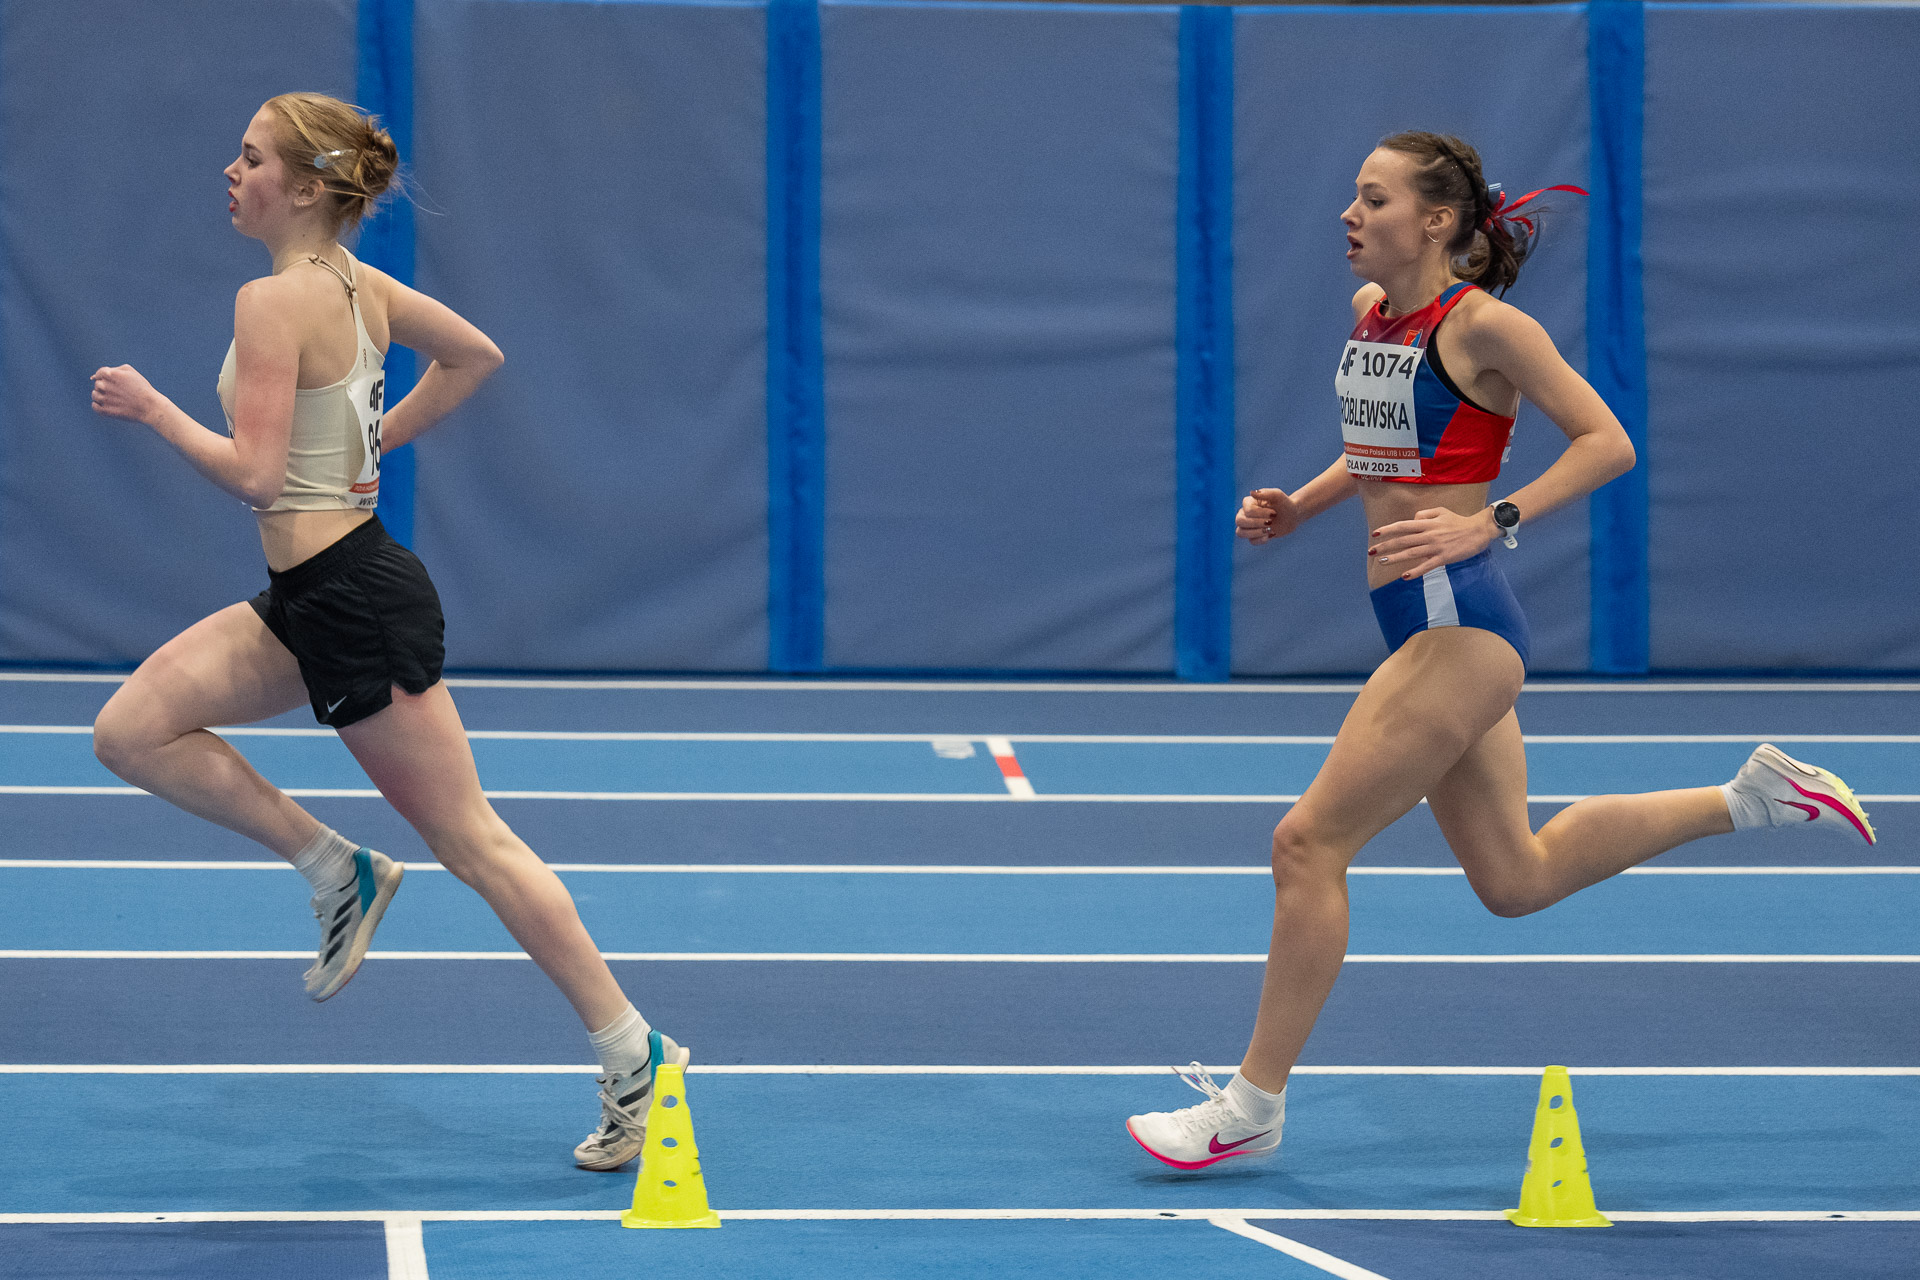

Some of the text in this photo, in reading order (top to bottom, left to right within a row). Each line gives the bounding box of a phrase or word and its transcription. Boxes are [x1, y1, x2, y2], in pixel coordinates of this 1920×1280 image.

[1362, 351, 1415, 380] 1074
[1338, 391, 1411, 430] RÓBLEWSKA
[1369, 448, 1386, 457] Polski
[1346, 459, 1399, 473] CŁAW 2025
